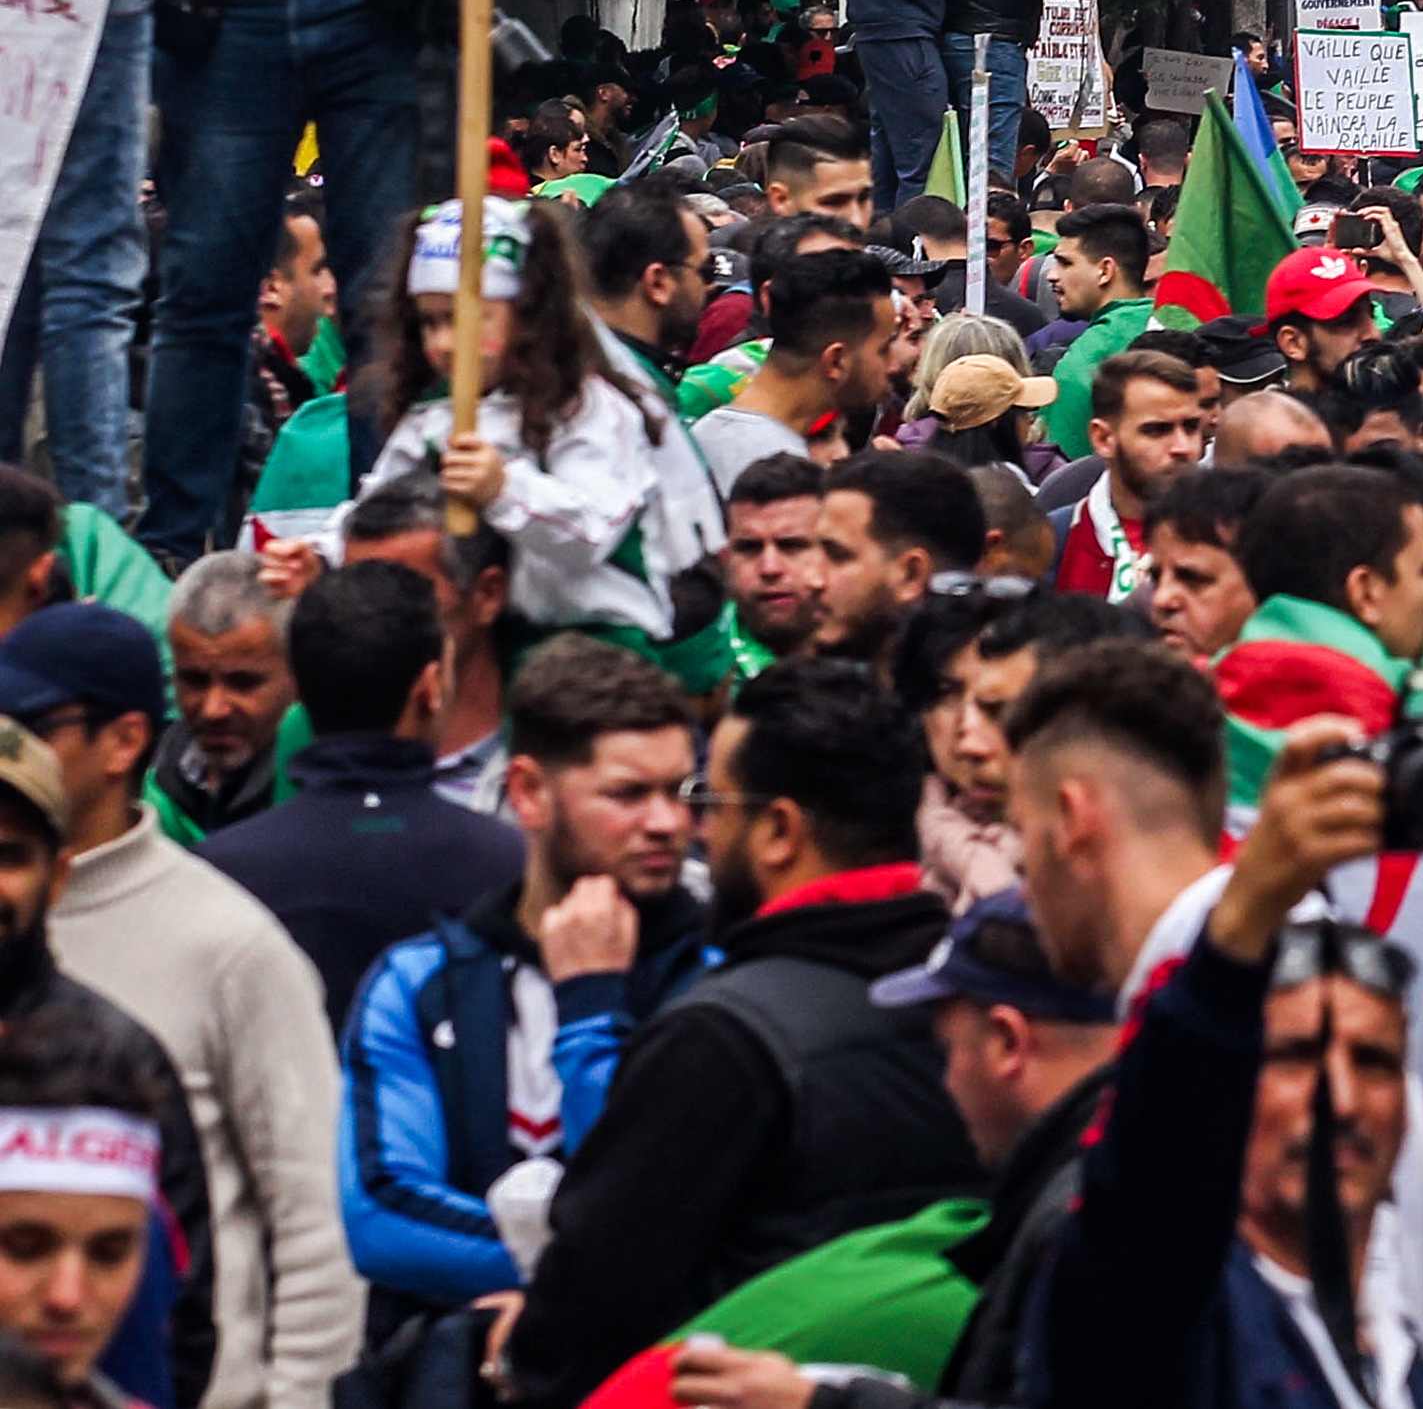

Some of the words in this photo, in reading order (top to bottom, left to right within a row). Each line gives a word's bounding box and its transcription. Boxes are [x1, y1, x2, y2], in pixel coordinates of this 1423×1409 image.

[1370, 43, 1406, 66] QUE
[1304, 91, 1326, 110] LE
[1335, 93, 1394, 111] PEUPLE
[1376, 116, 1397, 132] LA
